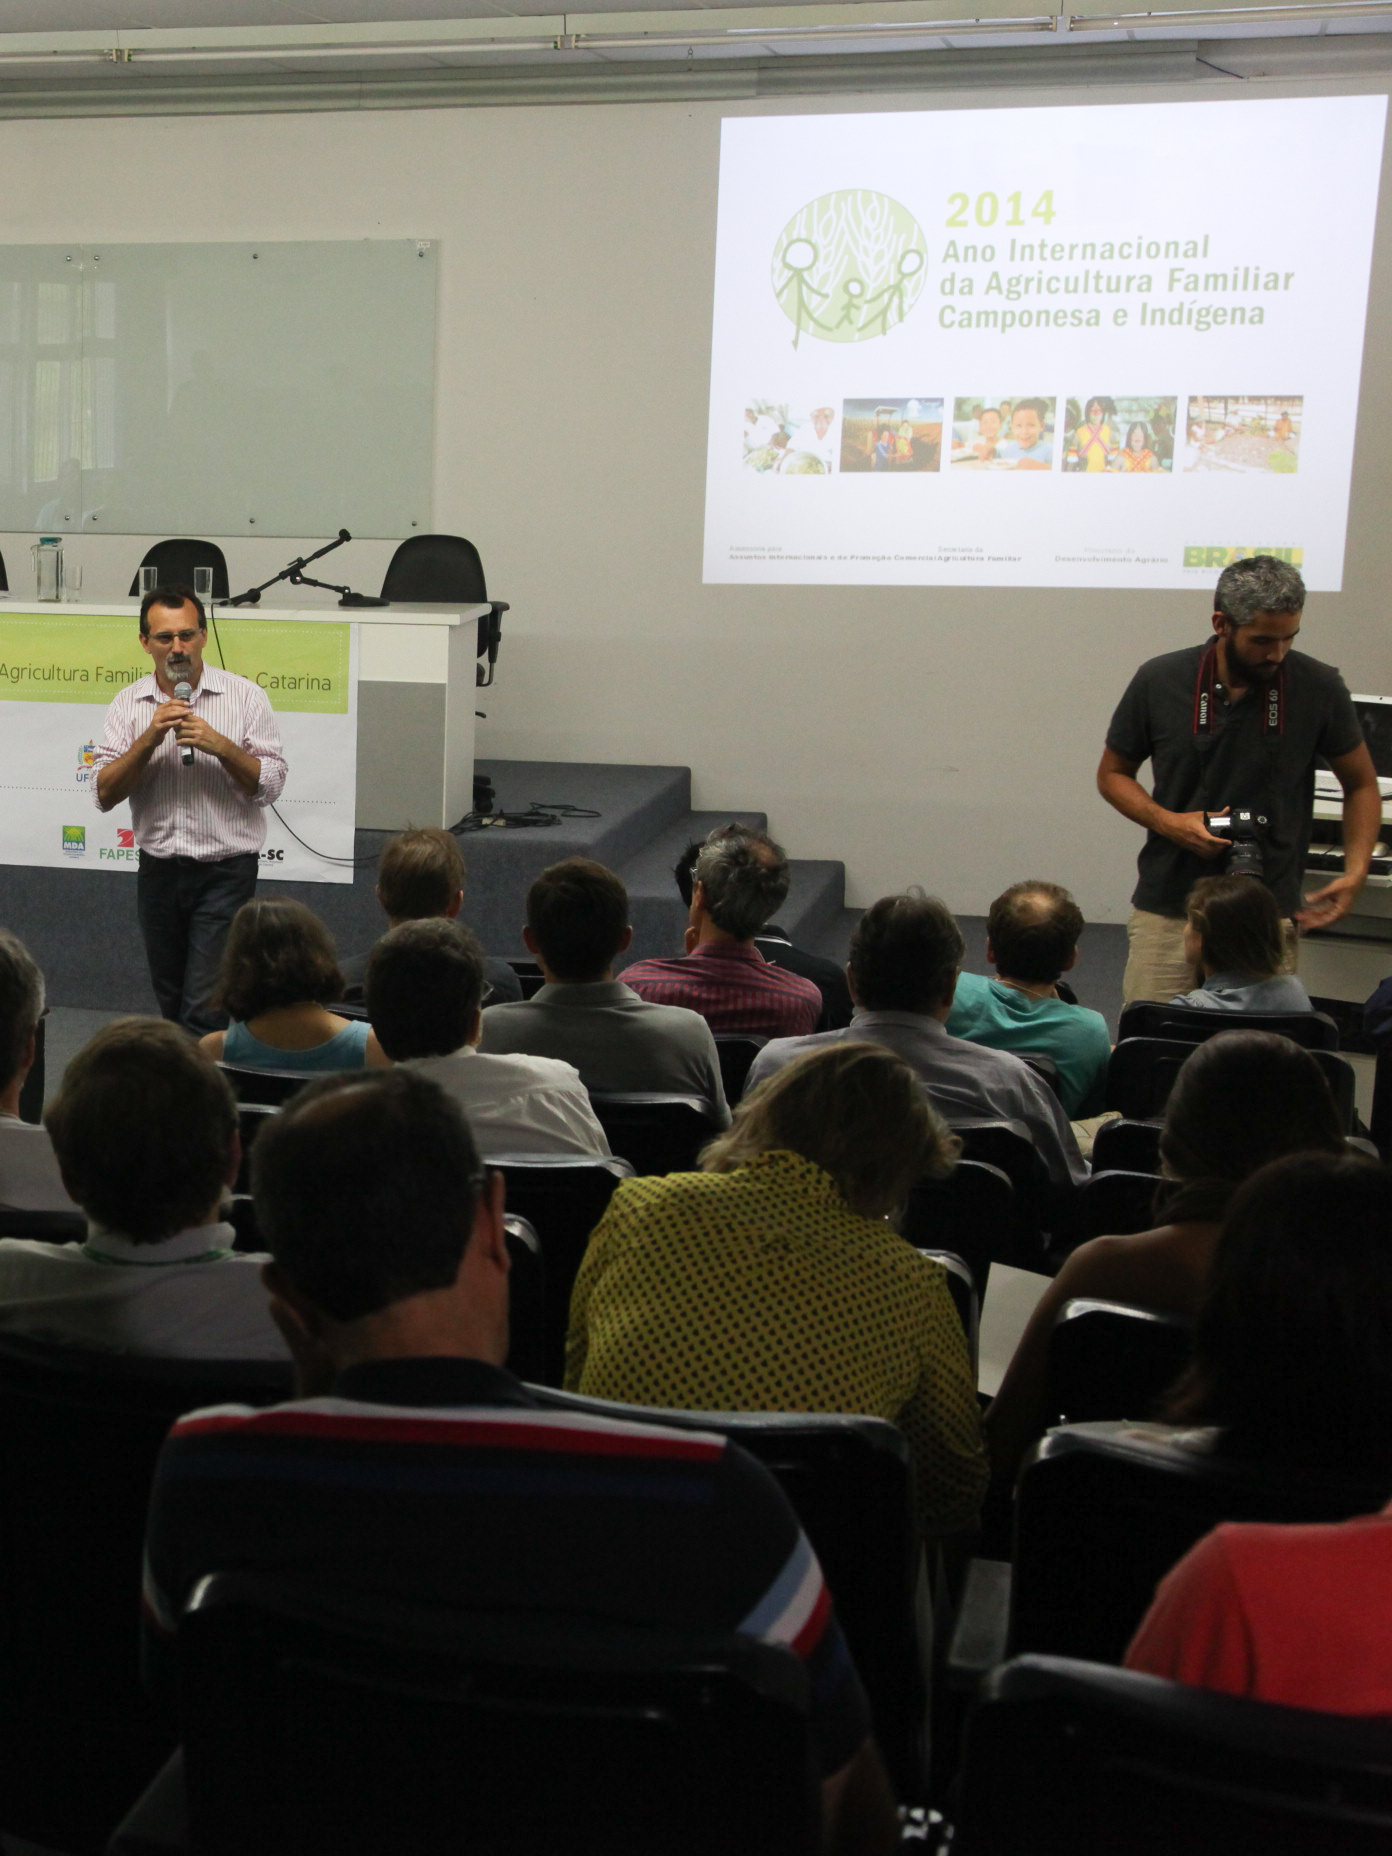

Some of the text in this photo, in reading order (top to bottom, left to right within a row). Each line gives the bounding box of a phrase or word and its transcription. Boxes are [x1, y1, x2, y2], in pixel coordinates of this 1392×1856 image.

[945, 189, 1056, 228] 2014
[942, 234, 1210, 264] Ano Internacional
[940, 266, 1295, 301] da Agricultura Familiar
[938, 300, 1265, 334] Camponesa e Indígena
[96, 666, 152, 683] Famili
[256, 672, 331, 691] Catarina
[1200, 692, 1209, 725] Canon
[1268, 703, 1278, 727] EOS
[64, 842, 84, 850] MDA
